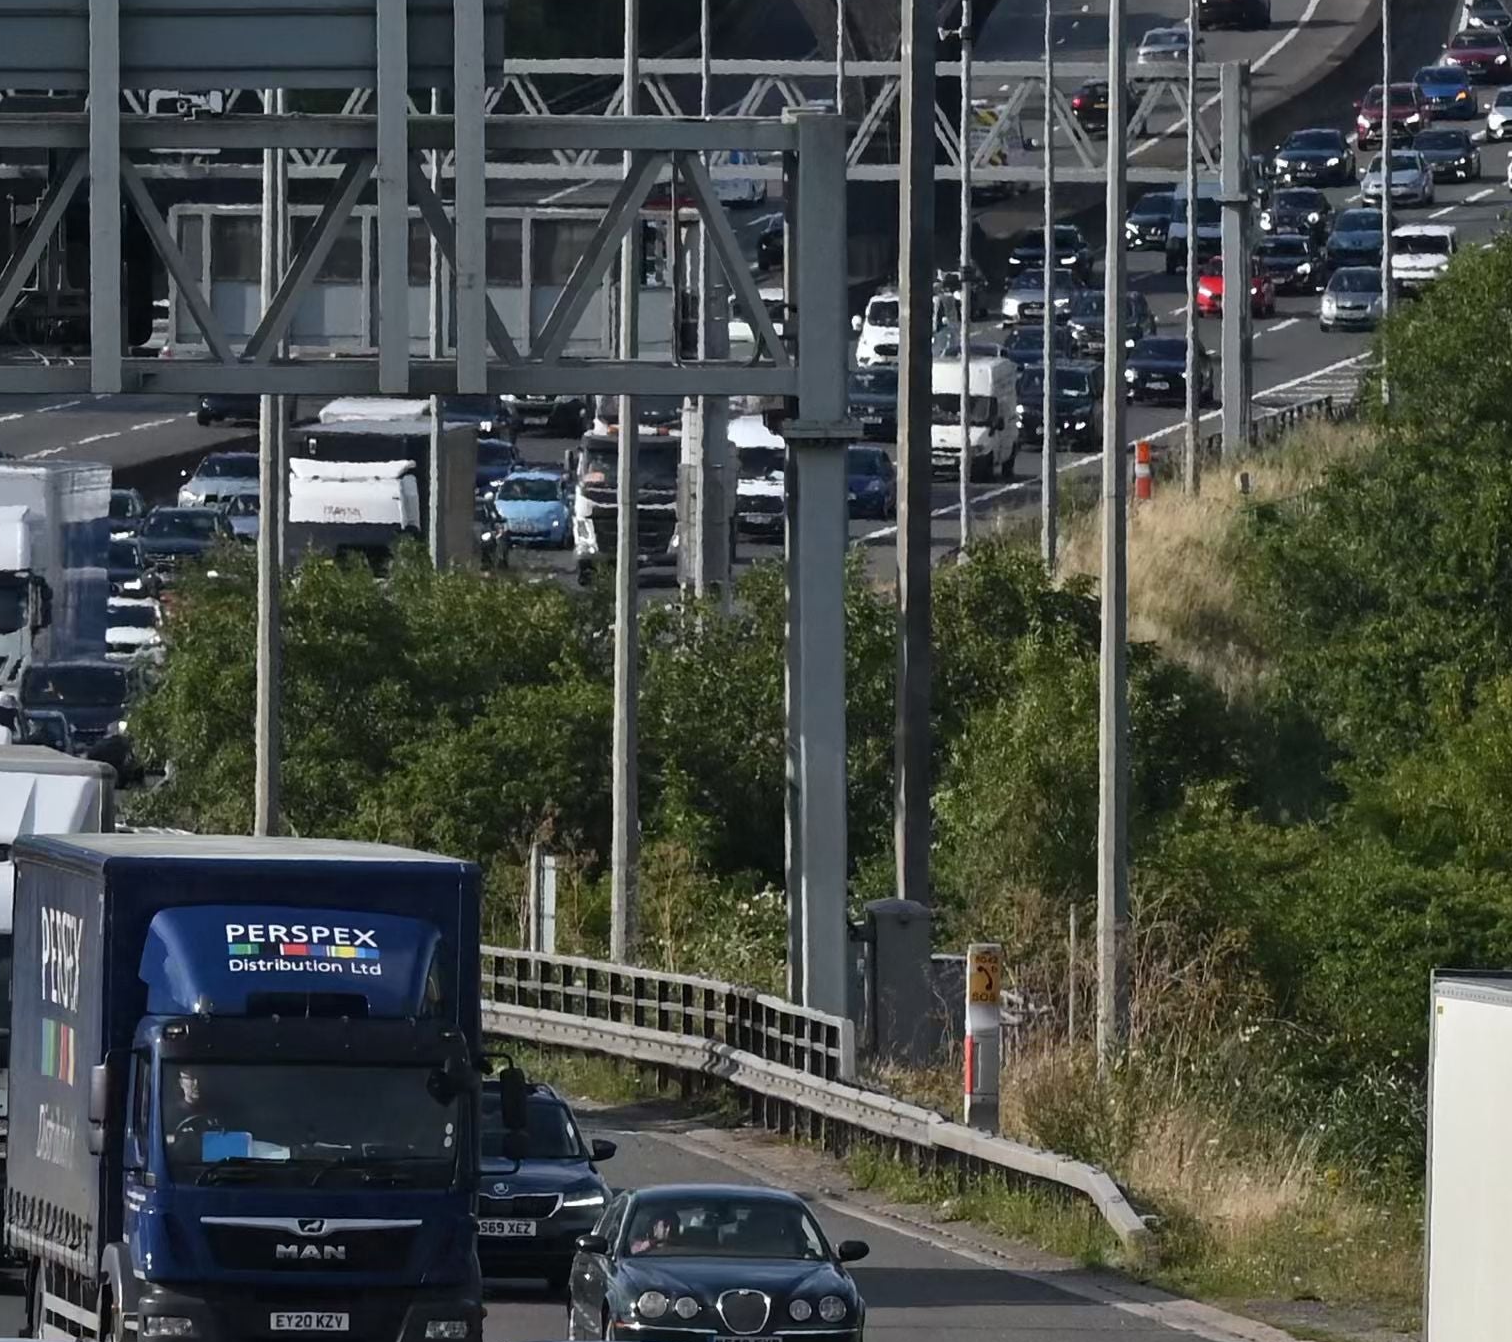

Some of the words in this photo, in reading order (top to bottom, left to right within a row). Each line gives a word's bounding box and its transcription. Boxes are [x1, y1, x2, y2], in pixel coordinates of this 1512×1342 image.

[226, 923, 378, 949] PERSPEX
[228, 958, 342, 974] Distribution
[352, 960, 382, 976] Ltd
[479, 1221, 507, 1234] S69
[275, 1244, 347, 1260] MAN
[276, 1314, 313, 1328] EY20
